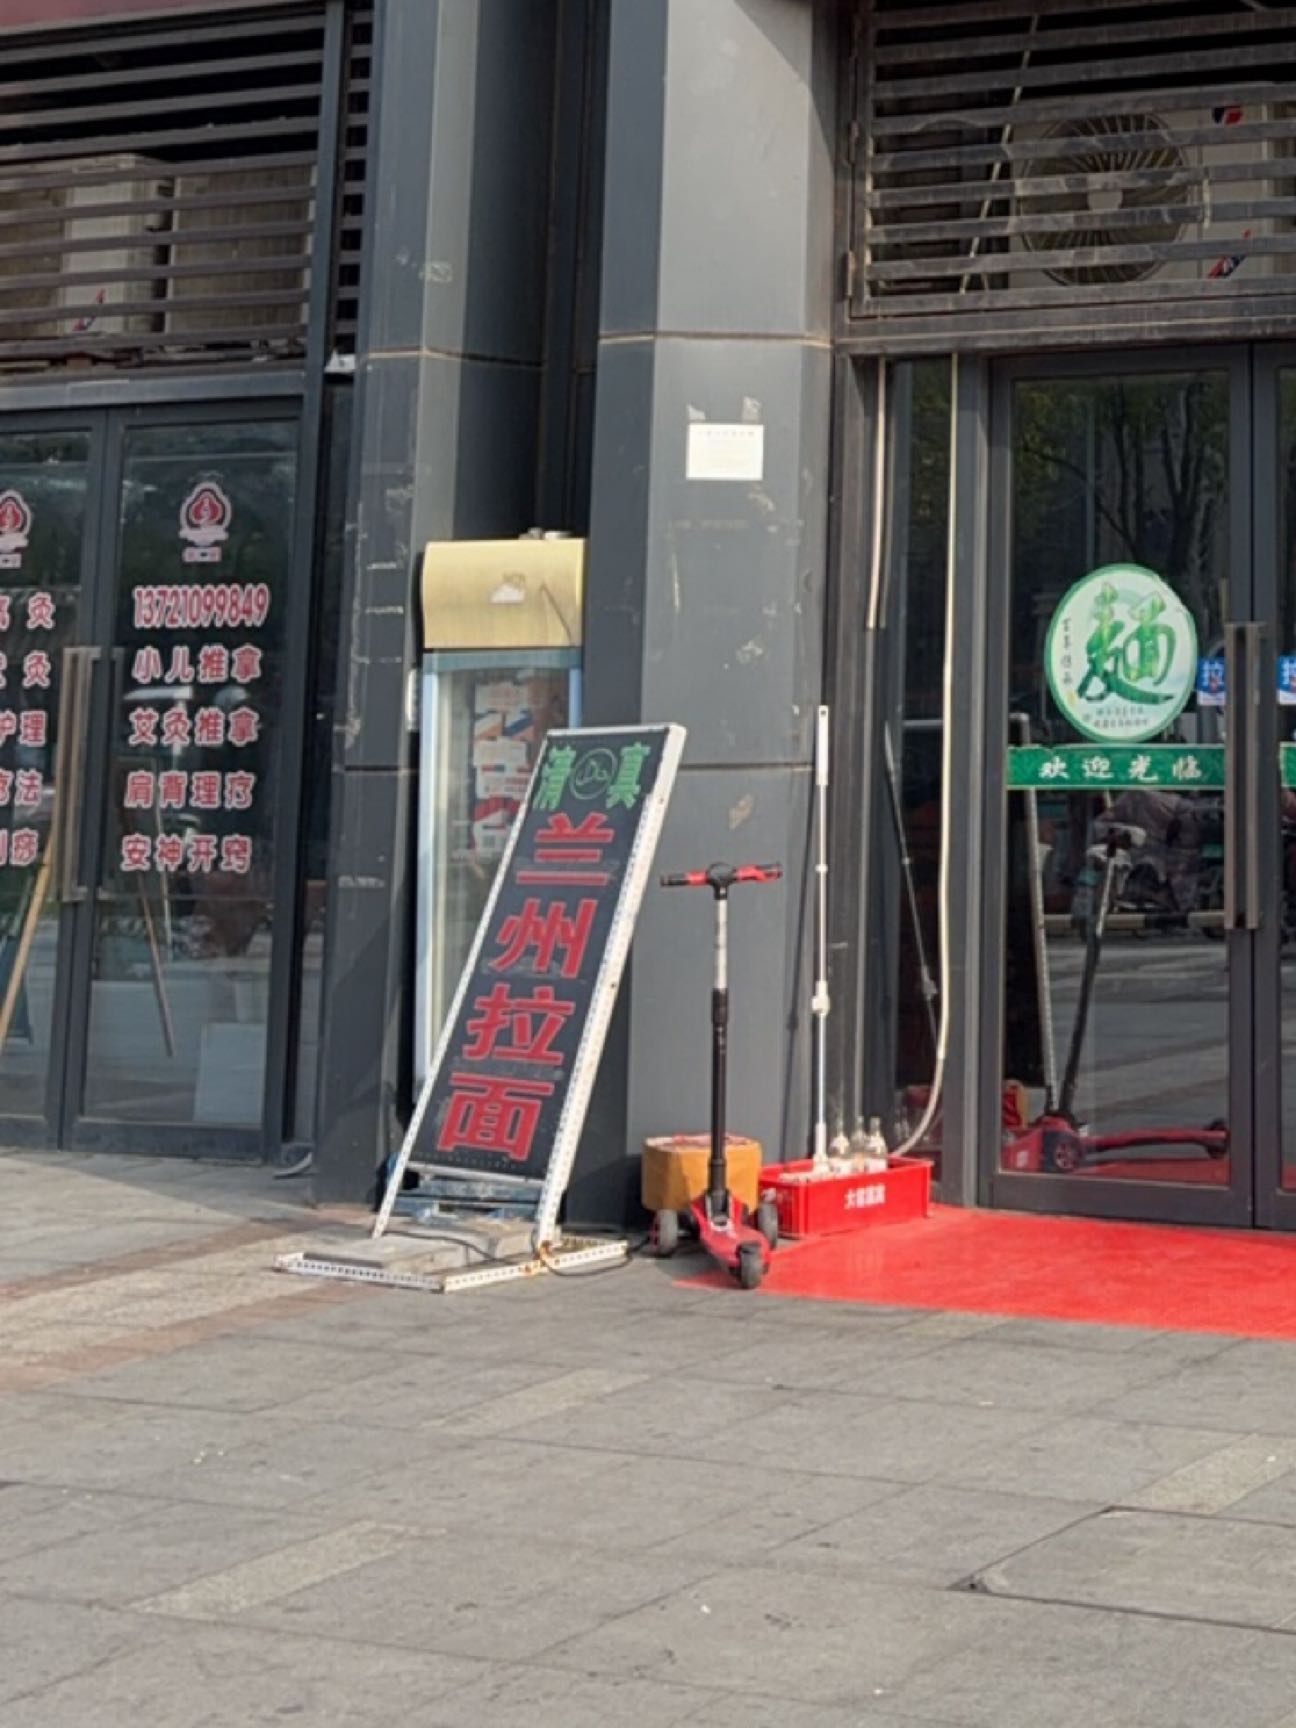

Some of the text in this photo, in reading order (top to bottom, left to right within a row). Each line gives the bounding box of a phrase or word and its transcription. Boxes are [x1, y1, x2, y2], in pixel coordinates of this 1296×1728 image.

[132, 583, 270, 629] 13721099849
[0, 650, 51, 688] 灸
[131, 644, 262, 685] 小儿推拿
[128, 706, 260, 747] 艾灸推拿
[531, 741, 652, 812] 清真
[1038, 753, 1204, 783] 欢迎光临
[123, 770, 256, 810] 肩背理疗
[0, 828, 39, 867] 痧
[120, 833, 253, 874] 安神开窍
[436, 810, 616, 1162] 兰州拉面
